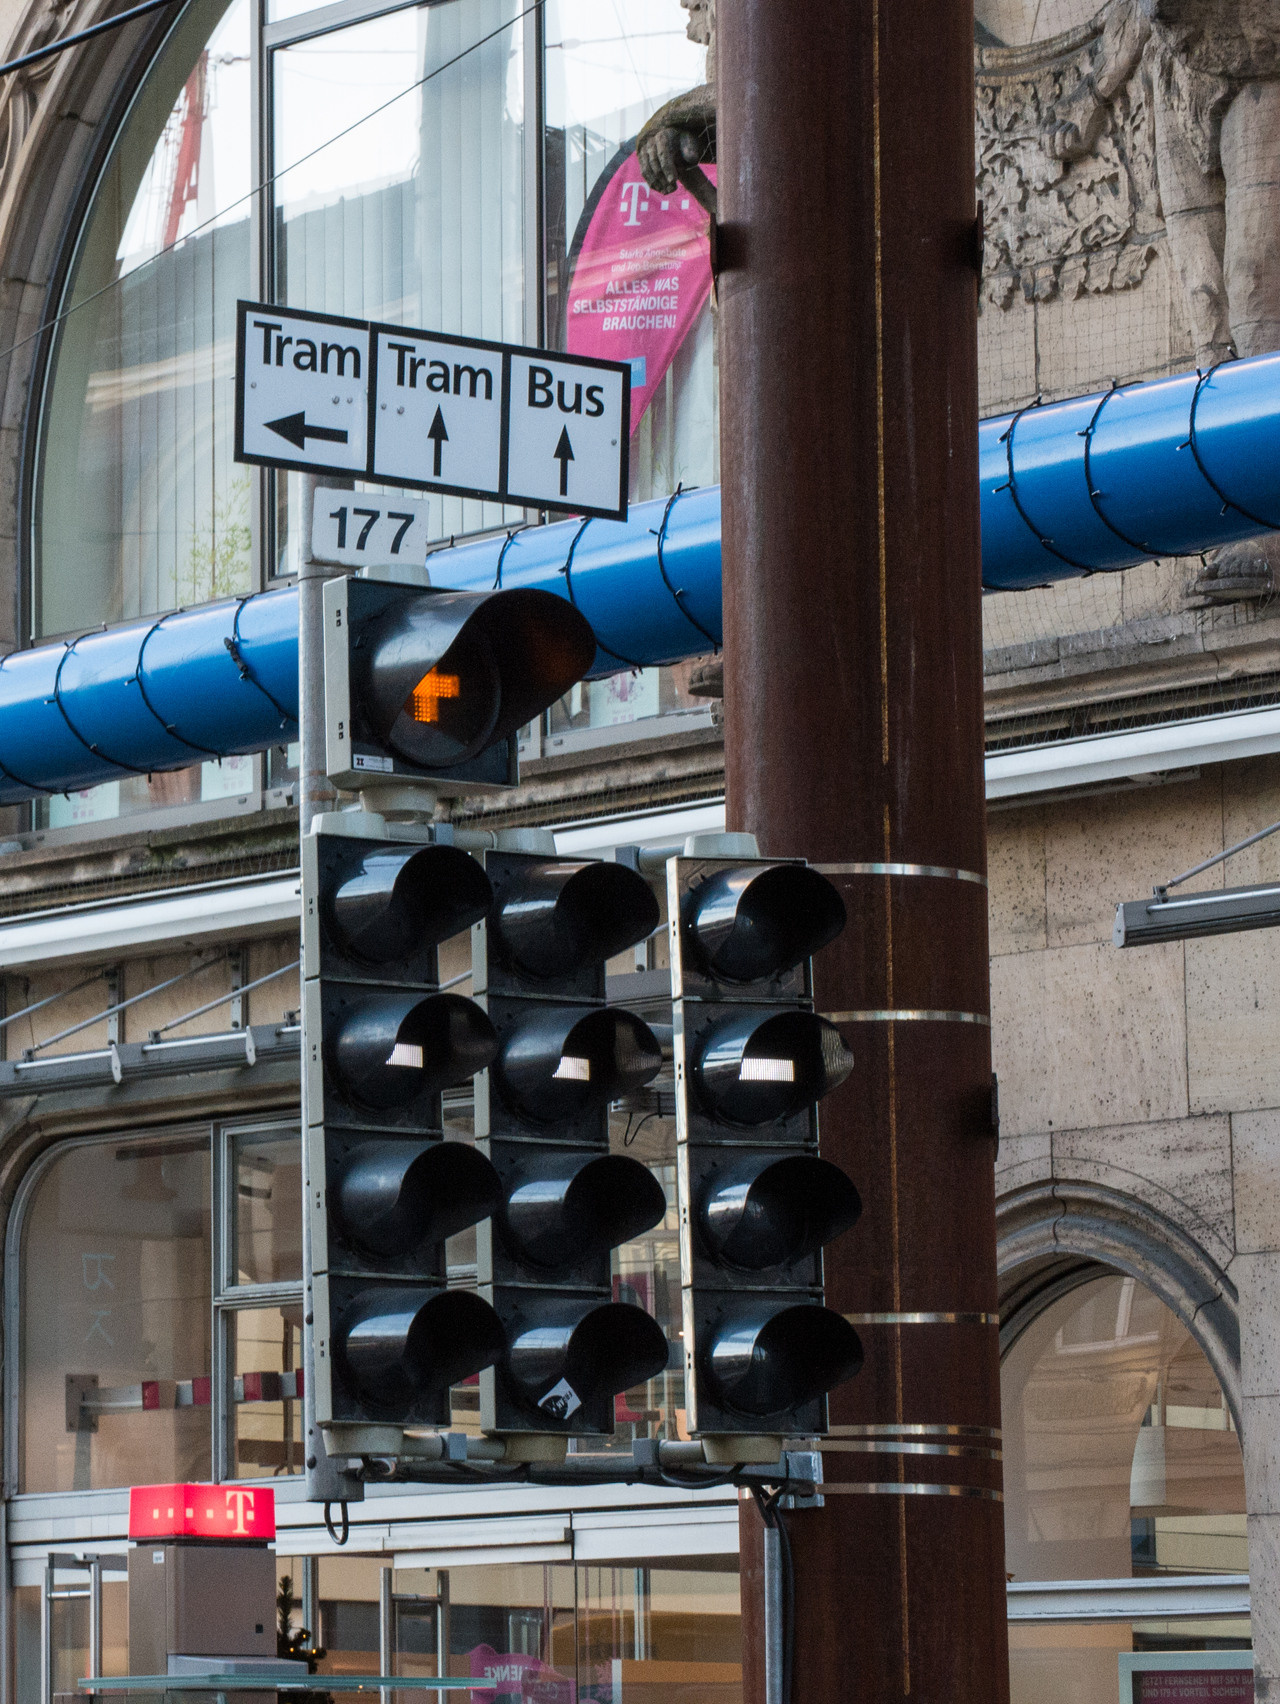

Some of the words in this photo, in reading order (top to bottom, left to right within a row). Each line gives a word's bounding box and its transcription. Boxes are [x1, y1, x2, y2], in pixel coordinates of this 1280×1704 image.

[611, 262, 626, 273] und
[606, 279, 651, 296] ALLES,
[654, 277, 680, 292] WAS
[573, 296, 678, 314] SELBSTSTÄNDIGE
[602, 315, 677, 332] BRAUCHEN!
[253, 321, 362, 379] Tram
[387, 342, 494, 400] Tram
[527, 365, 605, 418] Bus
[329, 506, 416, 555] 177
